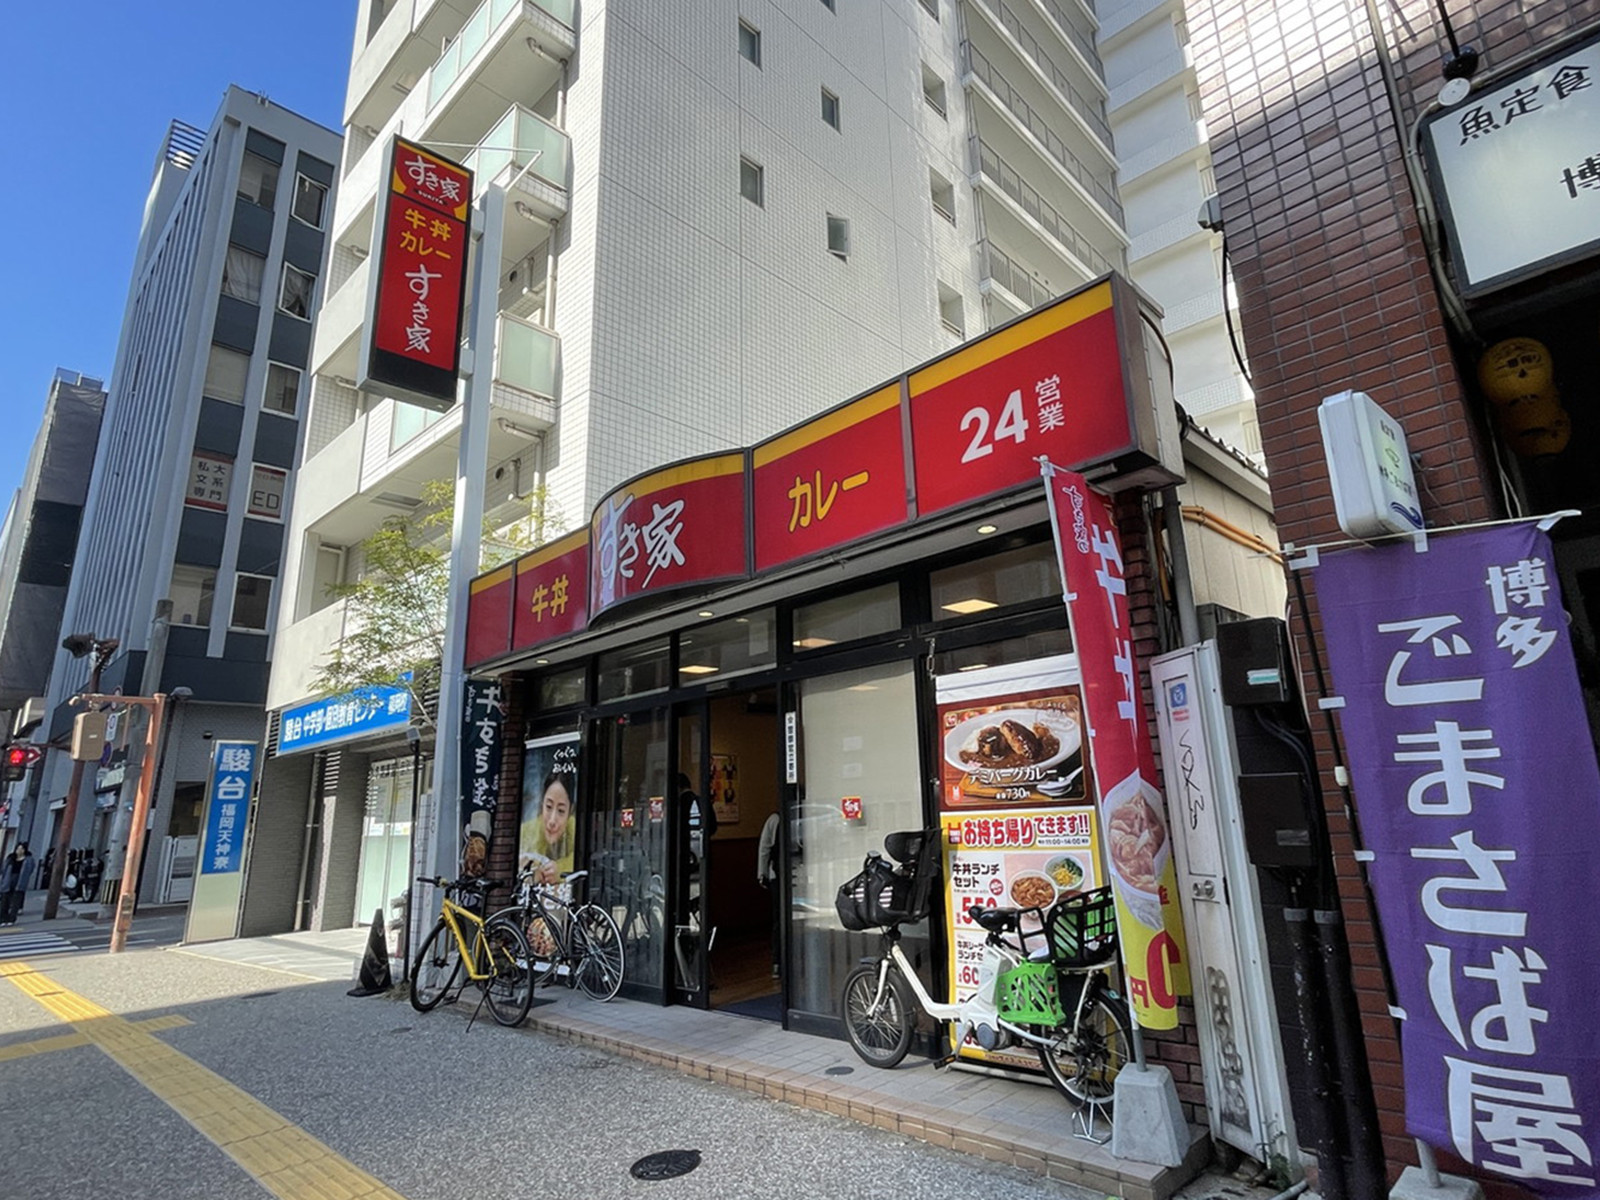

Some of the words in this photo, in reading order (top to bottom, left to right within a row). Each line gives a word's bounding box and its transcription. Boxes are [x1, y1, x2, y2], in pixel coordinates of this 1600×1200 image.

[404, 155, 460, 202] すき家
[400, 231, 452, 260] カレー
[404, 208, 452, 242] 牛丼
[404, 264, 442, 353] すき家
[960, 390, 1029, 464] 24
[1035, 374, 1065, 434] 営業
[787, 469, 870, 533] カレー
[600, 494, 686, 588] すき家
[530, 573, 570, 623] 牛丼
[1486, 557, 1558, 669] 博多
[218, 748, 252, 800] 駿台
[968, 767, 1058, 785] デミバーグカレー
[952, 862, 1000, 876] 牛丼ランチ
[953, 876, 980, 888] セット
[1378, 615, 1596, 1187] ごまさば屋
